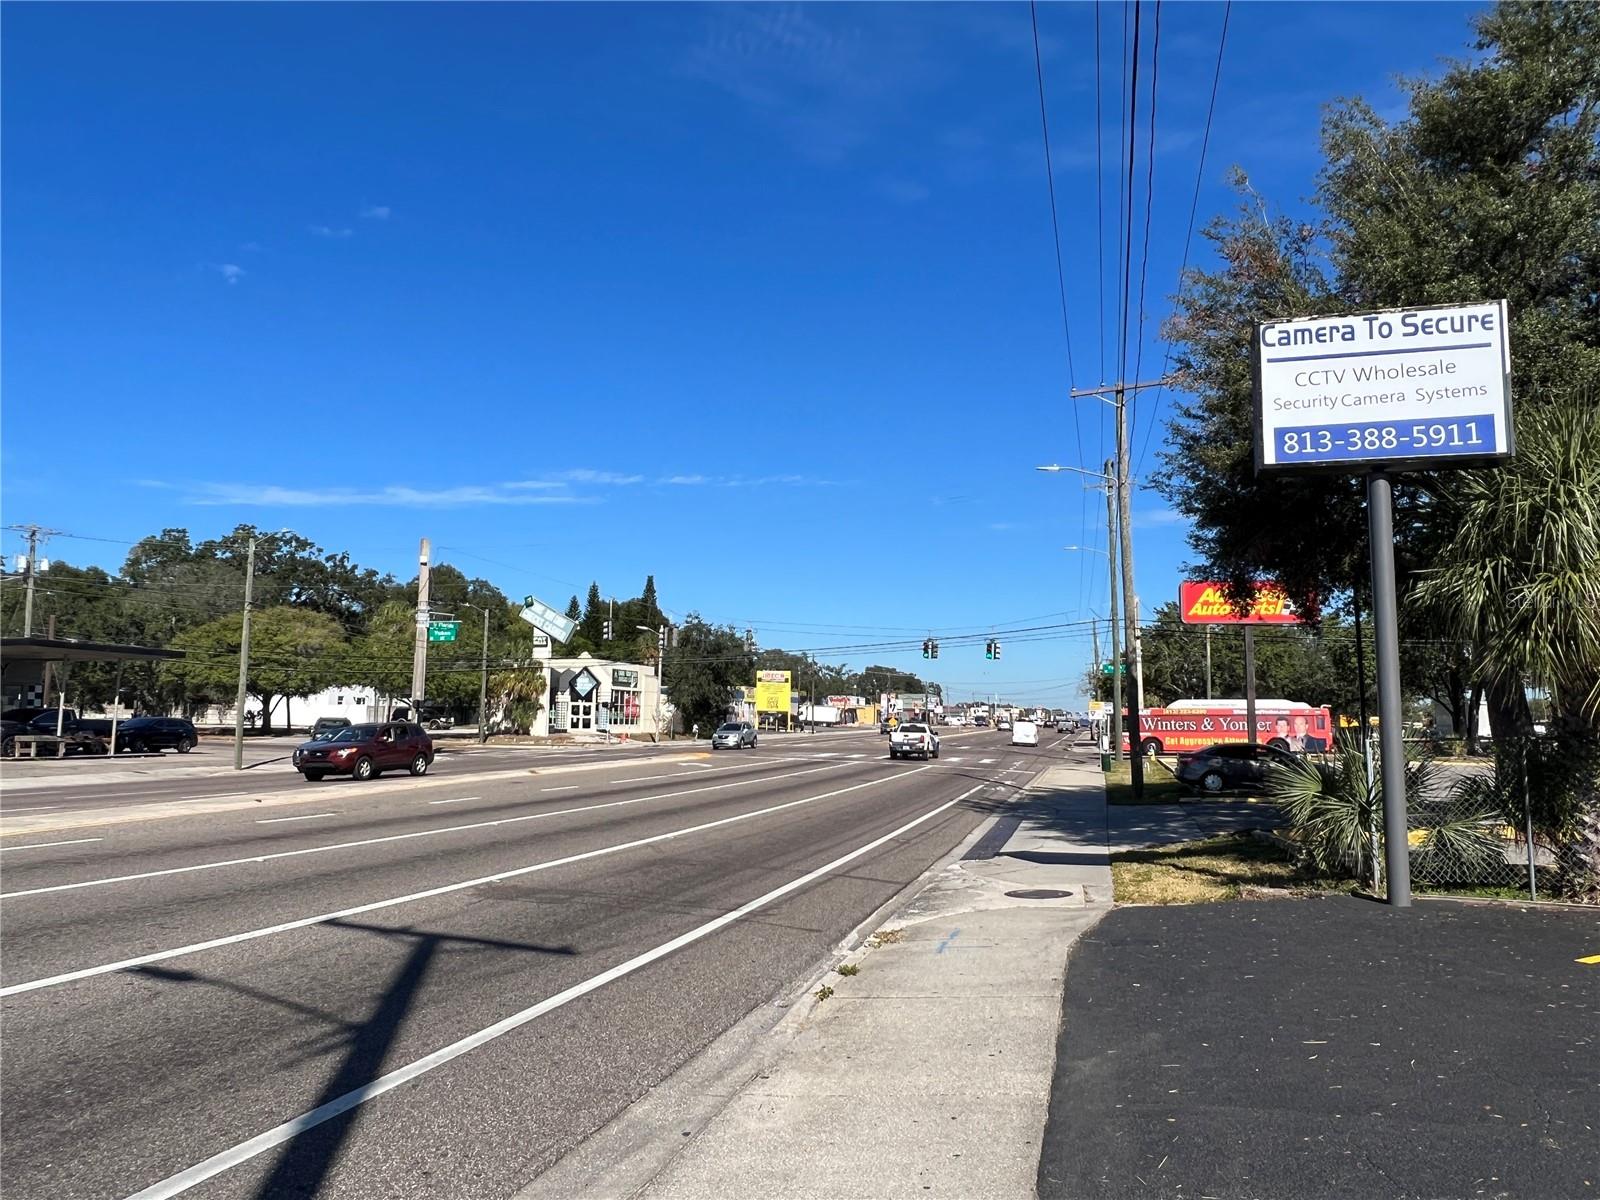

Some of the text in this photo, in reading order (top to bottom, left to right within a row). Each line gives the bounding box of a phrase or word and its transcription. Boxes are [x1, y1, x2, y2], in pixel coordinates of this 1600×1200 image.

[1261, 312, 1494, 348] Camera To Secure
[1294, 358, 1457, 387] CCTV Wholesale
[1273, 383, 1488, 411] Security Camera Systems
[1283, 421, 1483, 454] 813-388-5911
[1188, 602, 1231, 615] Auto
[1141, 717, 1272, 731] Winters & Yoner
